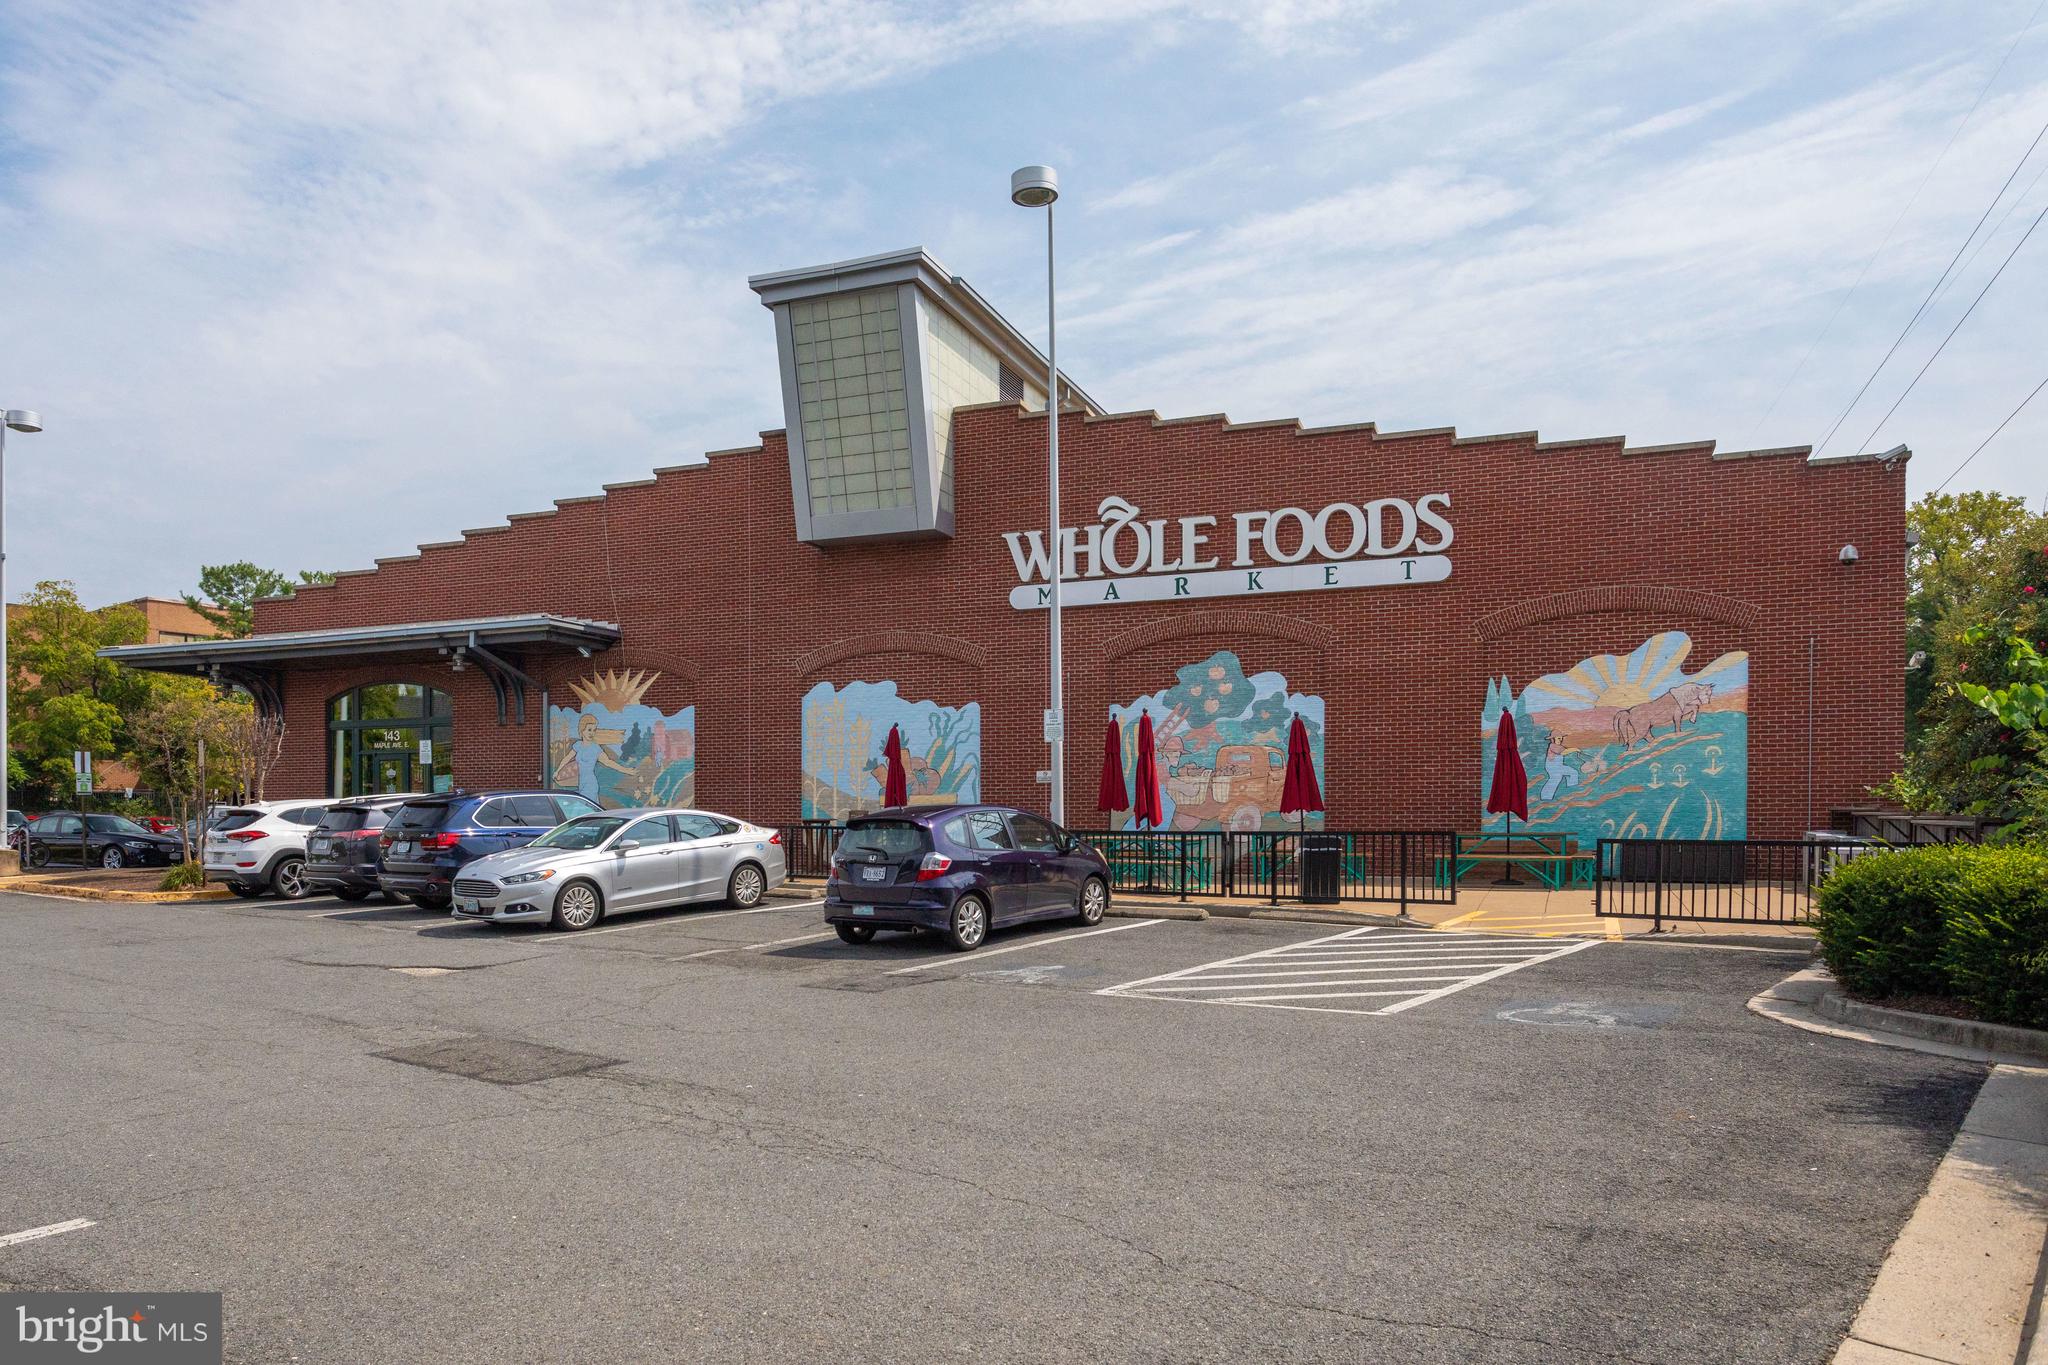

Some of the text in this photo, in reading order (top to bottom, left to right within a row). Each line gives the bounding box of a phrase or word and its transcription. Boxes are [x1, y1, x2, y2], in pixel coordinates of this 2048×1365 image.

[1002, 493, 1455, 582] WHOLE FOODS
[1038, 560, 1417, 606] MARKET
[384, 731, 400, 741] 143
